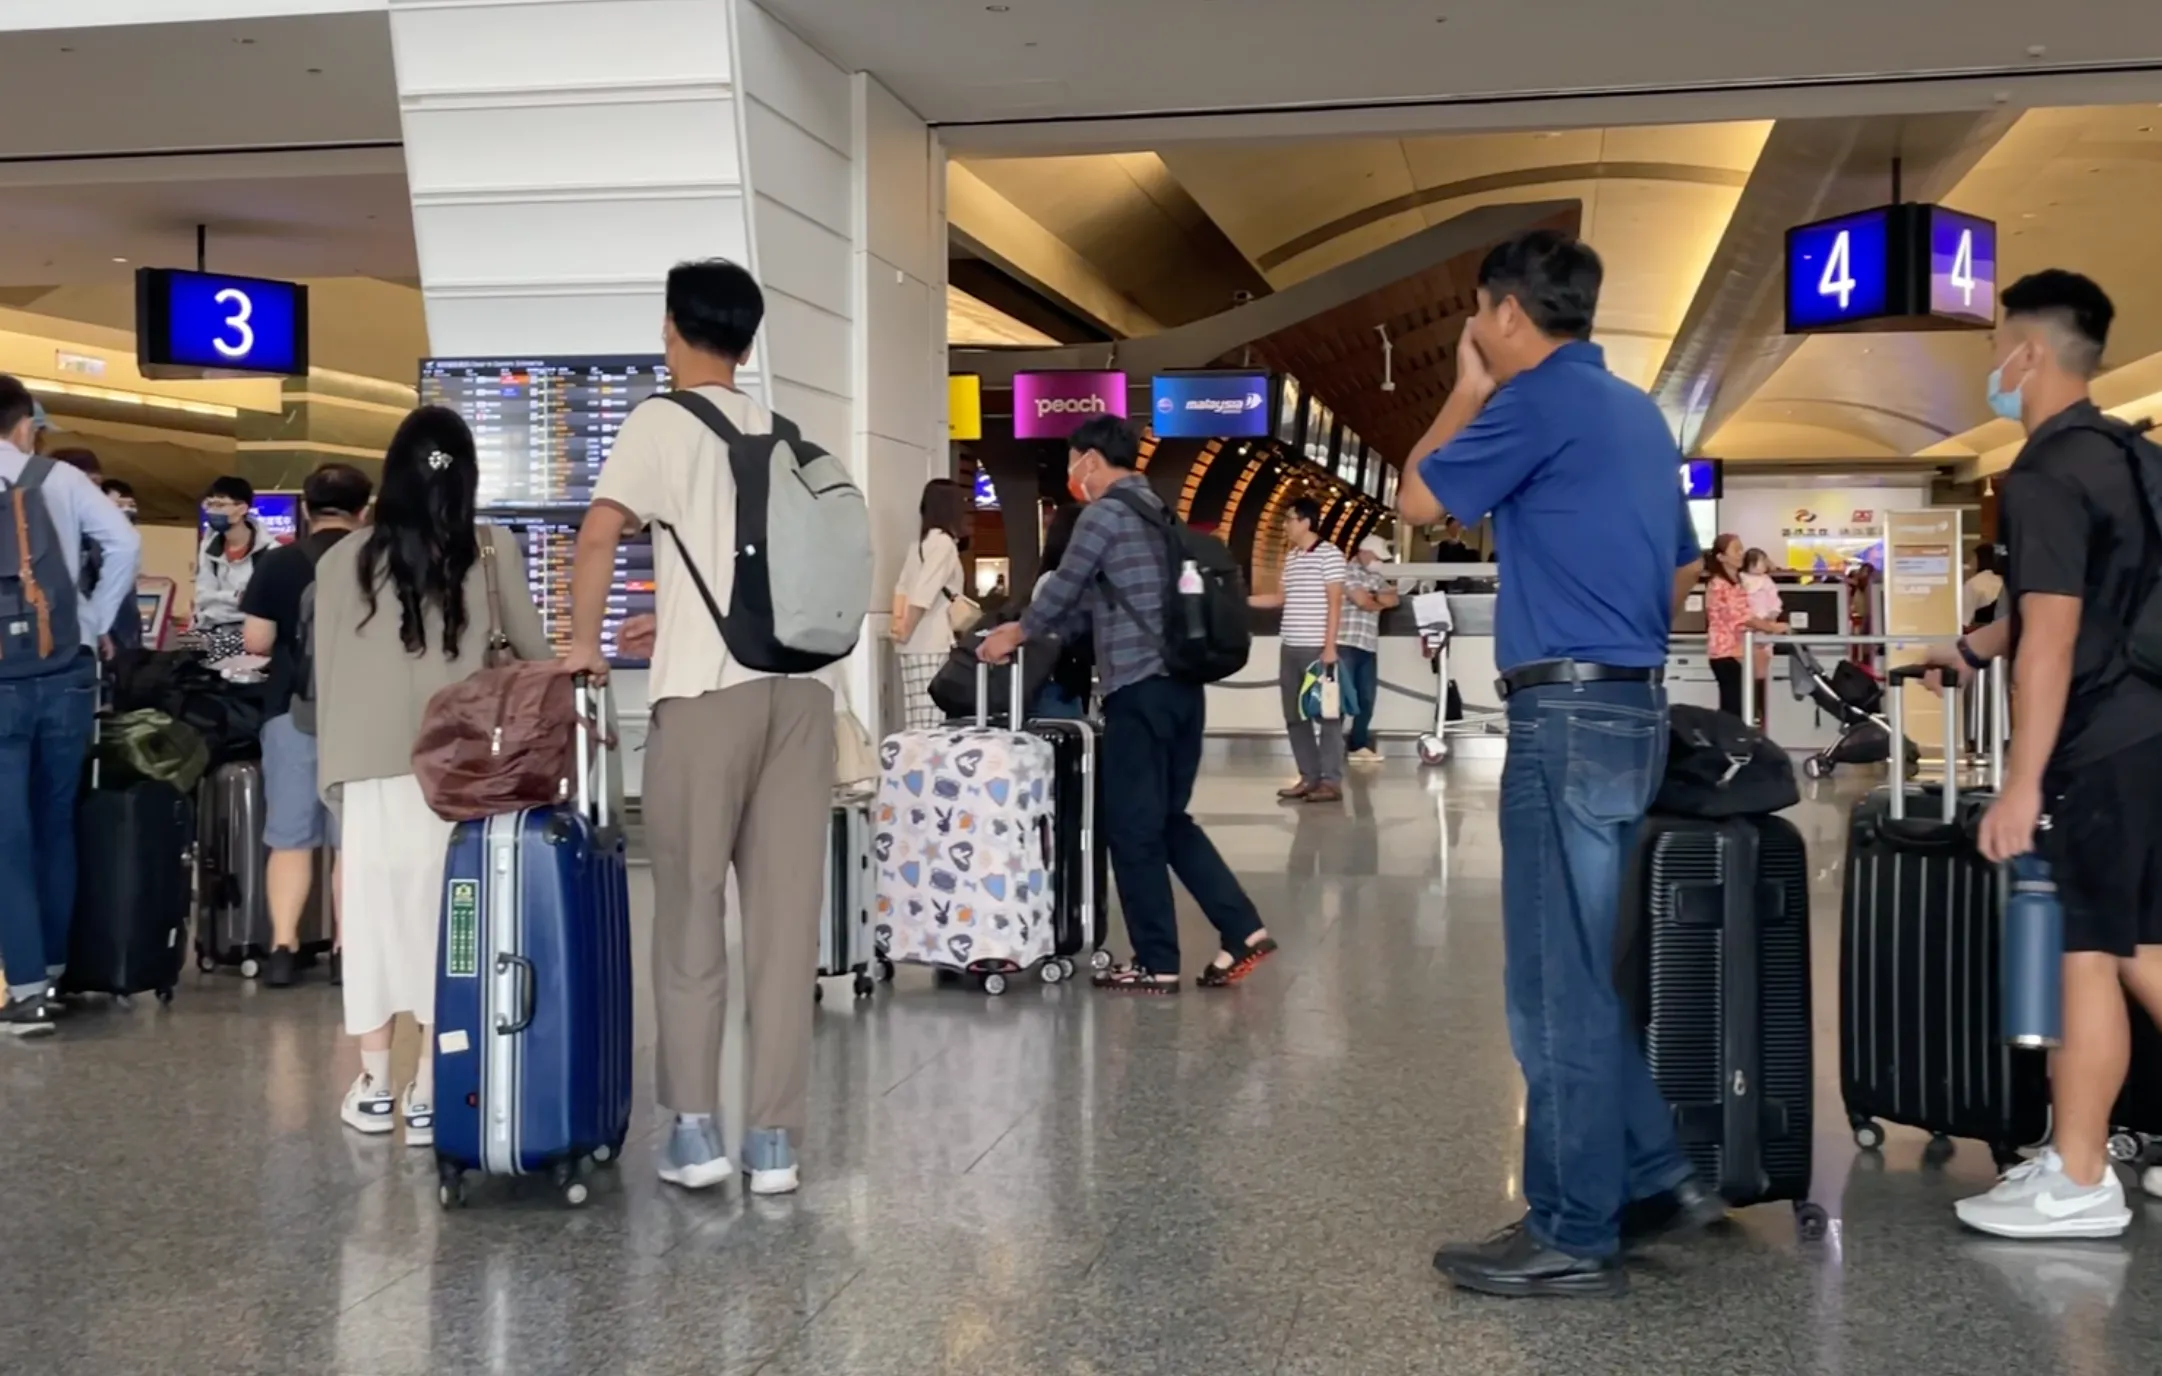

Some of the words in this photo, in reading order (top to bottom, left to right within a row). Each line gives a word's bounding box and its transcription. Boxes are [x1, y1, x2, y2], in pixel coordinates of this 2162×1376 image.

[1818, 229, 1857, 310] 4
[1951, 228, 1976, 308] 4
[212, 288, 256, 358] 3
[1035, 394, 1106, 417] peach
[1186, 398, 1244, 413] malaysia
[975, 468, 998, 504] 3
